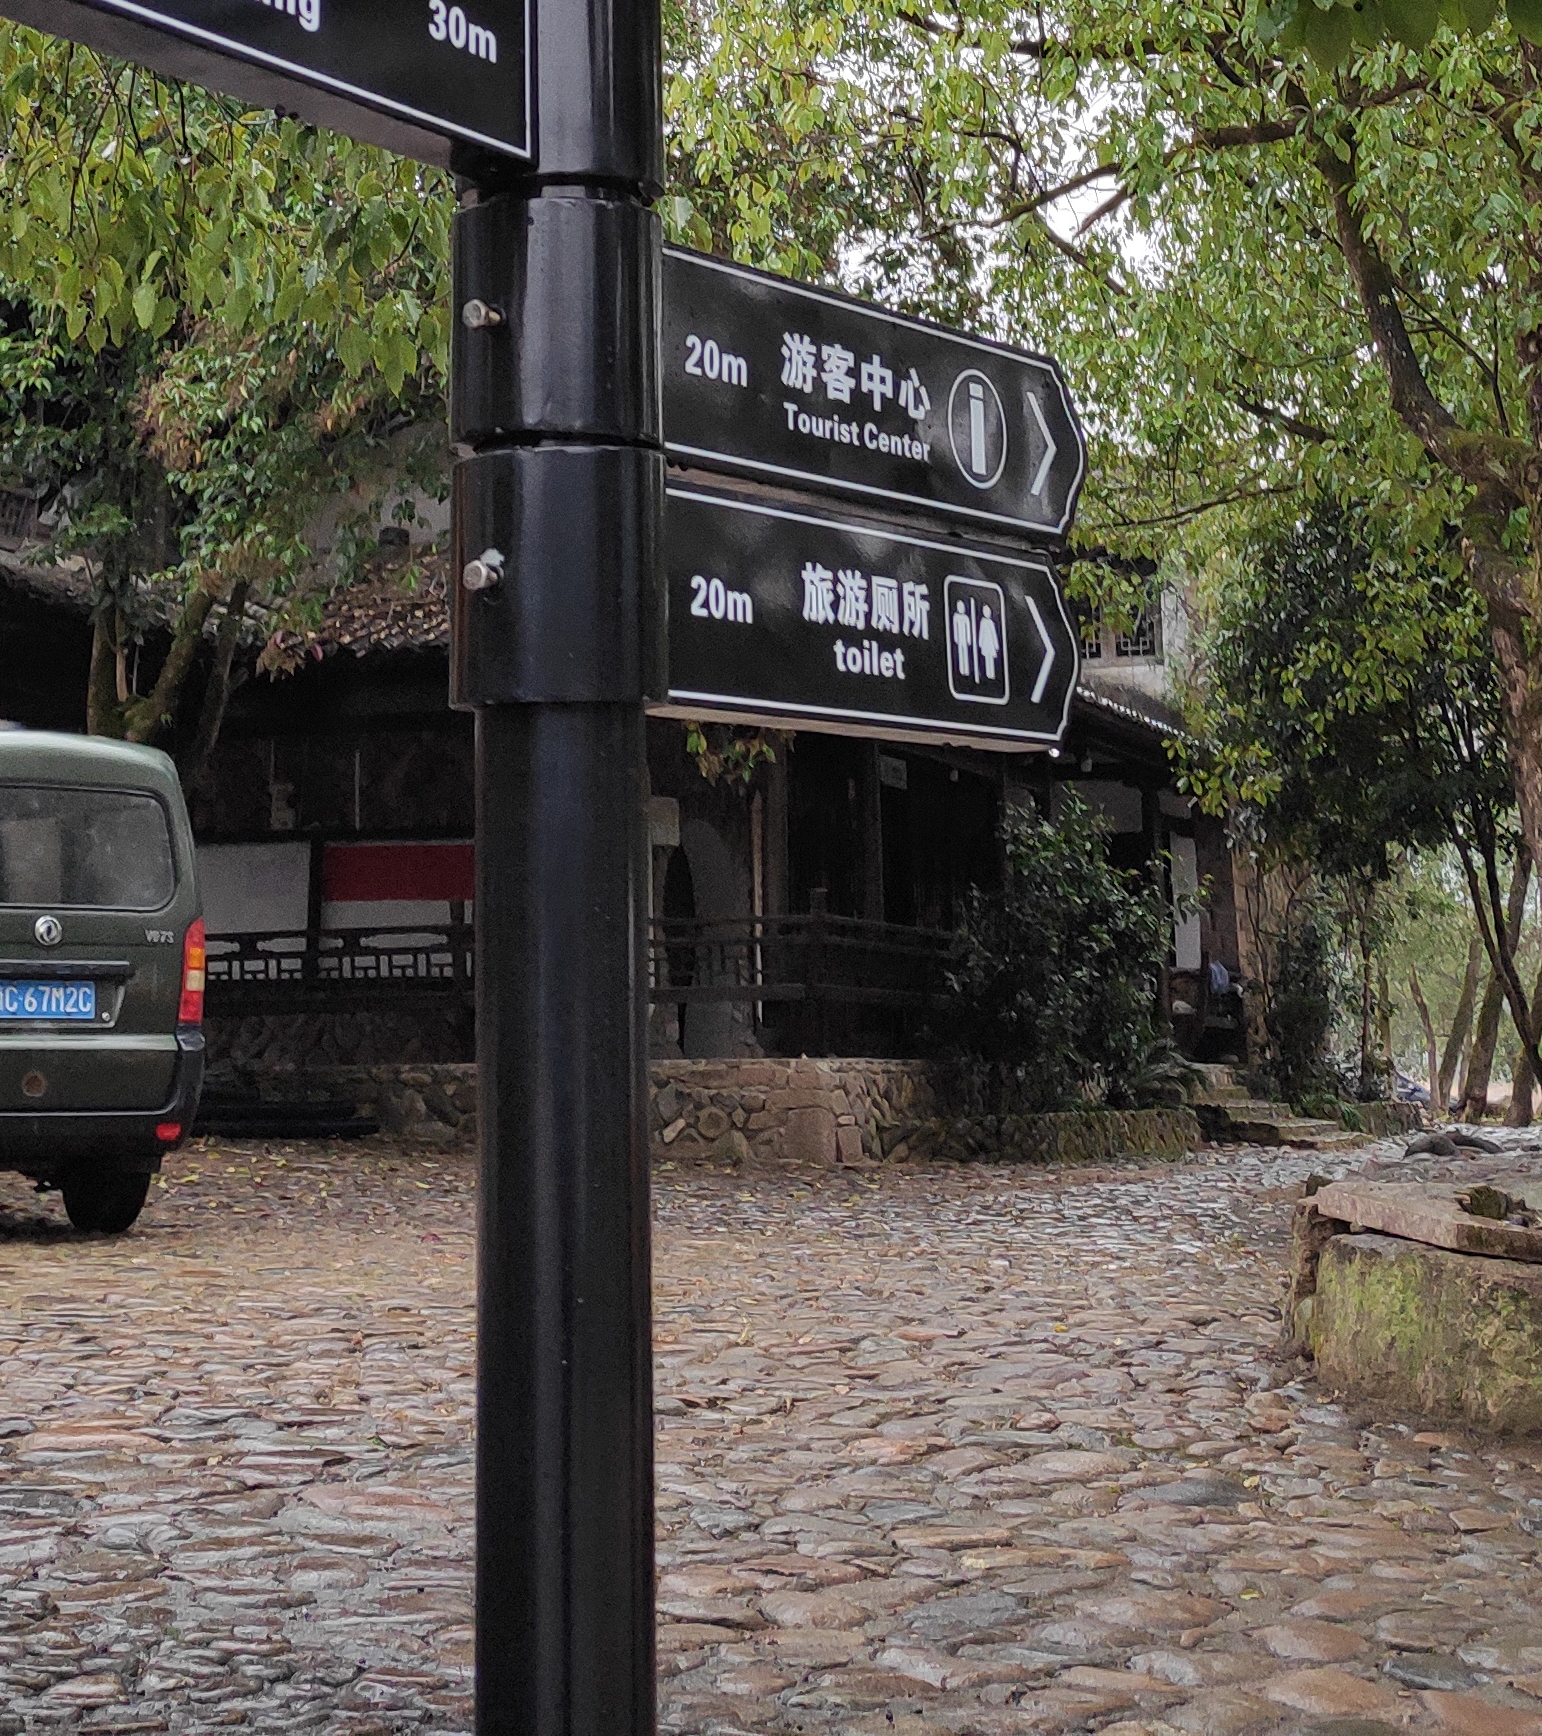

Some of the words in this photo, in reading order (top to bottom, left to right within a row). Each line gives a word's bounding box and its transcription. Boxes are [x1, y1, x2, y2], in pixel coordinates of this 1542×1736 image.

[684, 333, 749, 389] 20m
[780, 330, 932, 421] 游客中心
[782, 401, 860, 447] Tourist
[863, 421, 931, 463] Center
[690, 574, 754, 625] 20m
[800, 561, 931, 641] 旅游厕所
[832, 638, 906, 681] toilet
